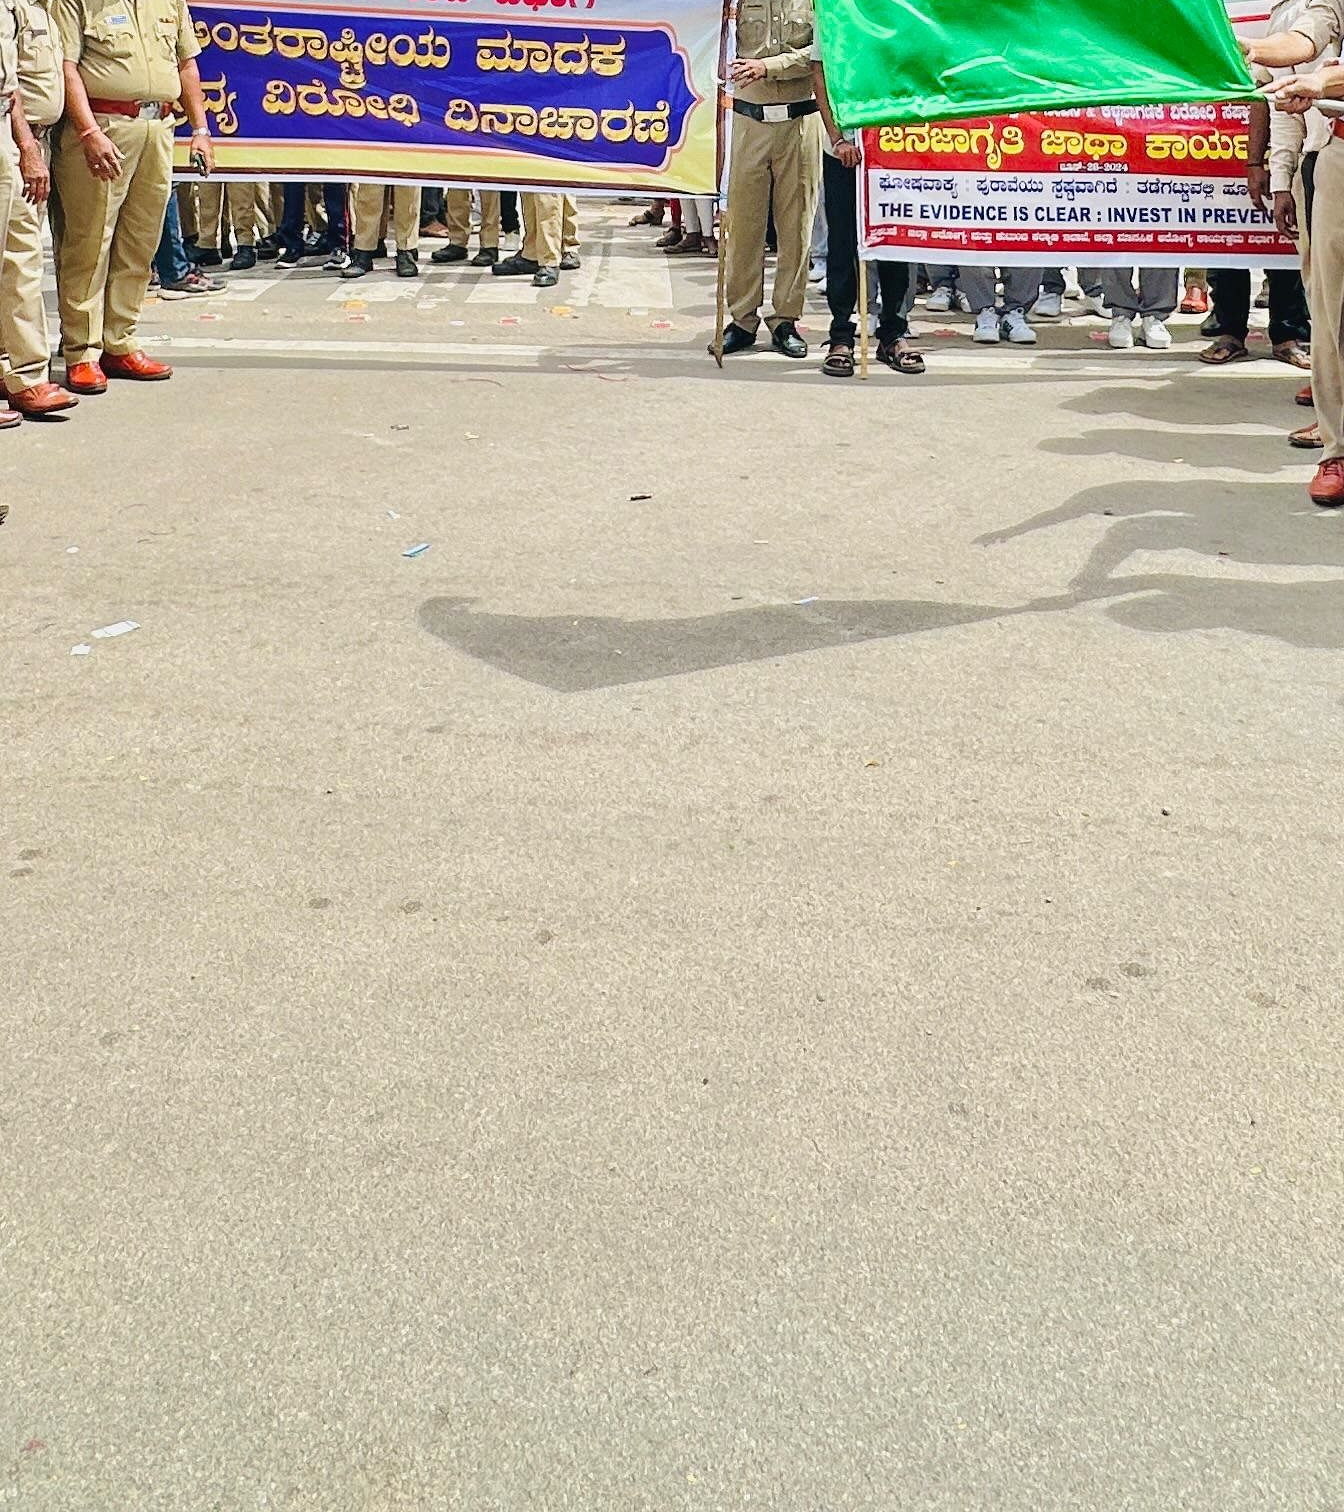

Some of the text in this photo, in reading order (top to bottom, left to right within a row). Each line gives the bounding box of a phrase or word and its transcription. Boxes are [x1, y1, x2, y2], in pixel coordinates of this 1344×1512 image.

[475, 23, 627, 78] ಮಾದಕ
[261, 77, 422, 129] ವಿರೋಧಿ
[878, 120, 1025, 171] ಜನಜಾಗೃತಿ
[1040, 128, 1128, 161] ಜಾಥಾ
[879, 202, 914, 218] THE
[919, 204, 1007, 221] EVIDENCE
[1013, 206, 1029, 221] IS
[1034, 206, 1091, 223] CLEAR
[1108, 207, 1172, 224] INVEST
[1178, 208, 1197, 224] IN
[1202, 208, 1274, 224] PREVEN
